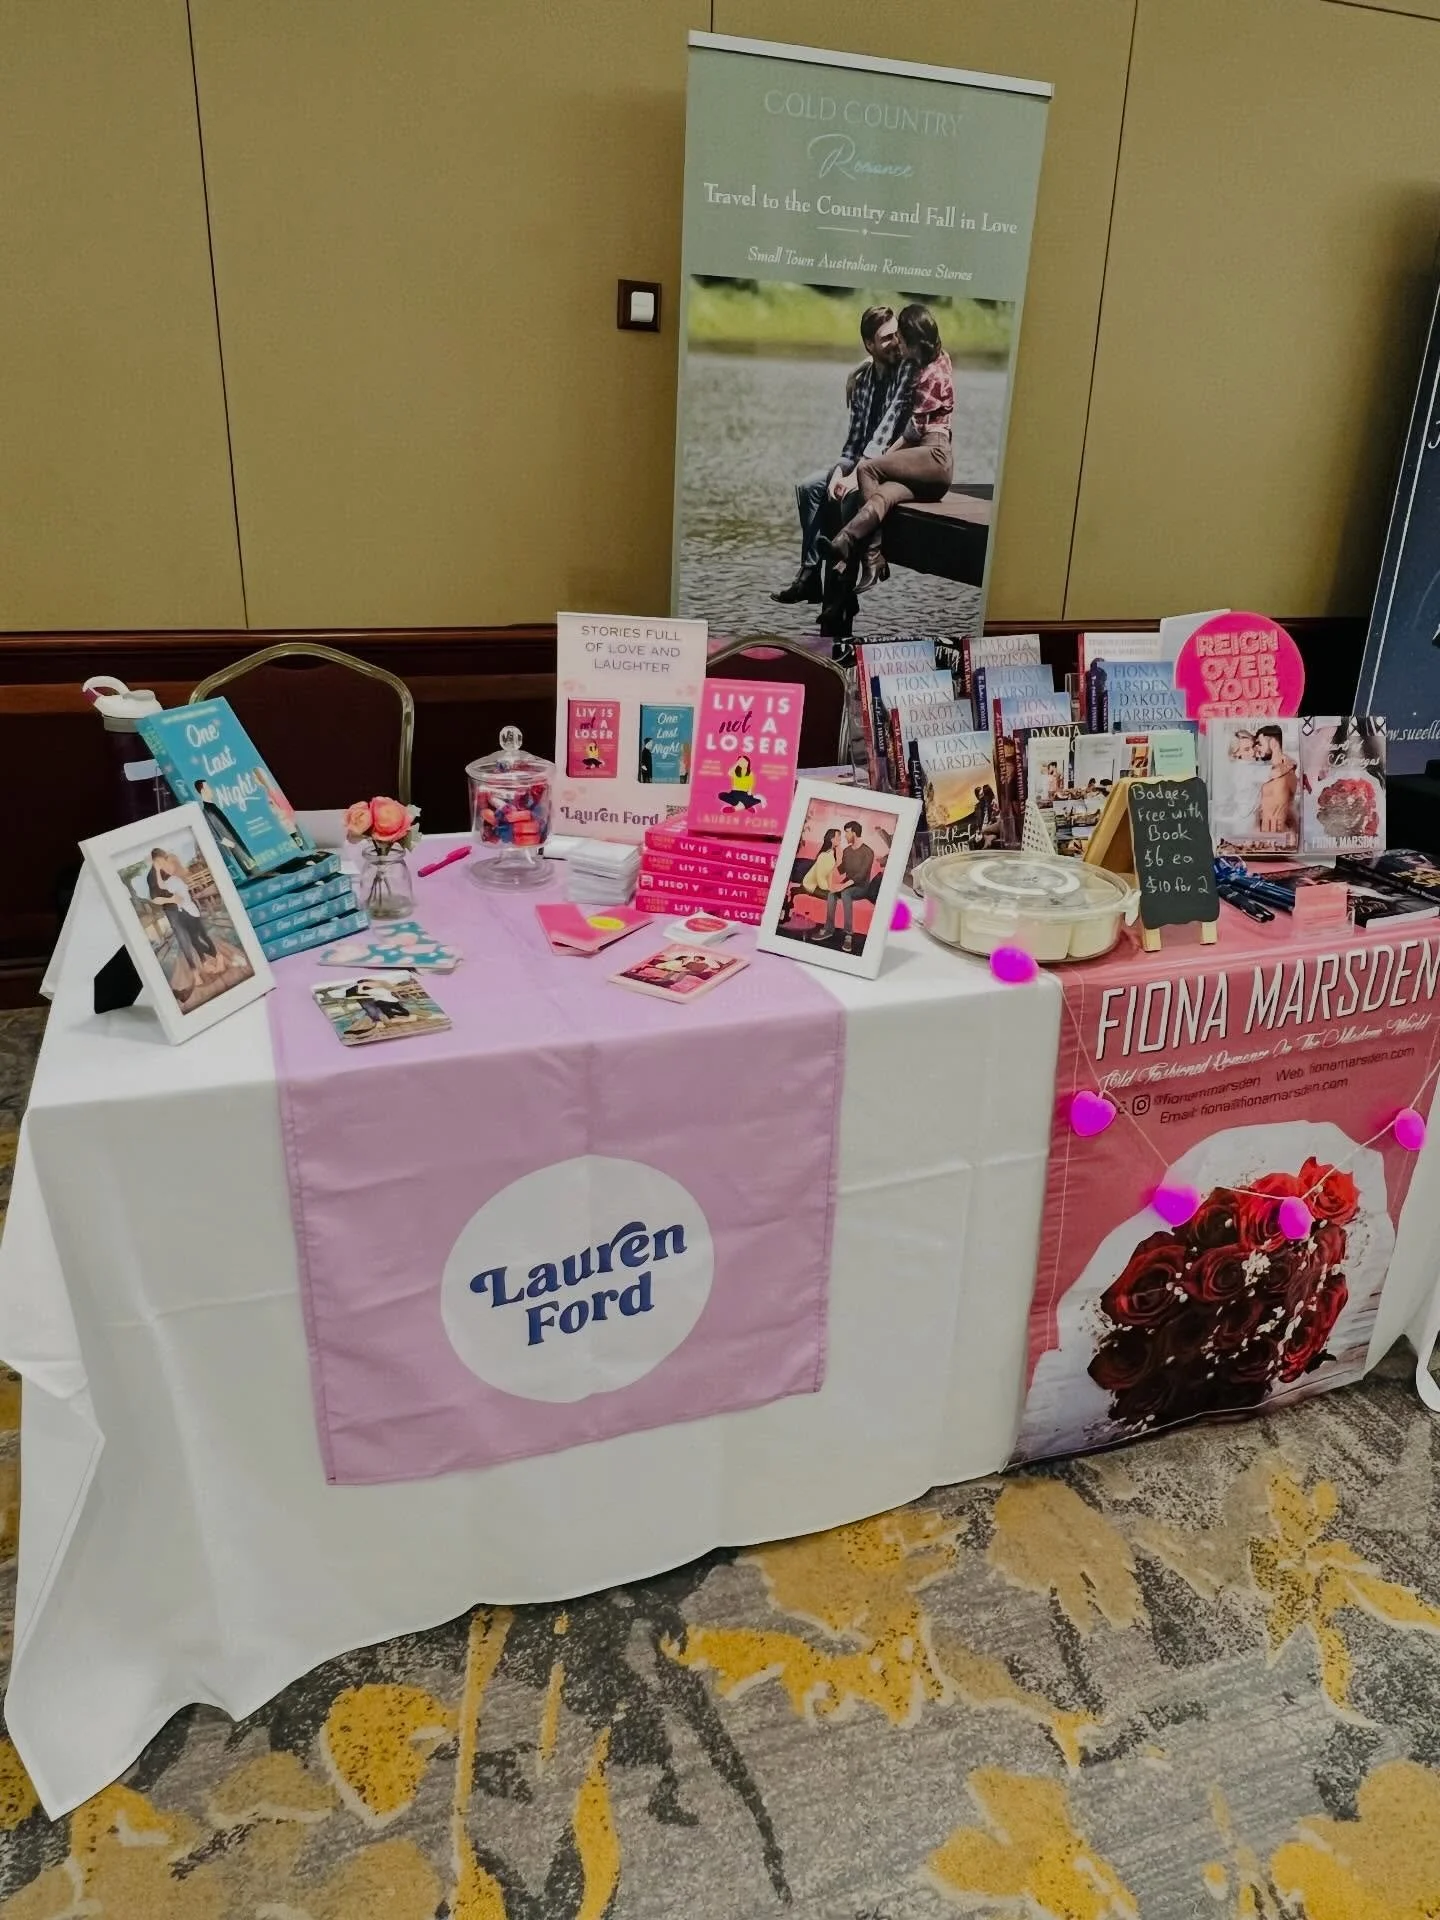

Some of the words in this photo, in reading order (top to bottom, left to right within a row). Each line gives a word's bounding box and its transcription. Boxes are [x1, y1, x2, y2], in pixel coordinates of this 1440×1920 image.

[844, 101, 963, 137] COUNTRY
[703, 183, 757, 207] Travel
[763, 192, 779, 209] to
[785, 189, 811, 213] the
[817, 196, 885, 223] Country
[890, 204, 920, 225] and
[927, 207, 955, 228] Fall
[961, 212, 976, 230] in
[982, 213, 1018, 234] Love
[747, 246, 782, 264] Small
[786, 249, 814, 267] Town
[819, 254, 877, 273] Australian
[883, 258, 932, 277] Romance
[936, 264, 973, 280] Stories
[581, 625, 640, 638] STORIES
[646, 629, 681, 641] FULL
[1197, 629, 1279, 657] REIGN
[585, 642, 603, 652] OF
[608, 644, 646, 656] LOVE
[651, 647, 681, 658] AND
[872, 646, 927, 661] DAKOTA
[594, 660, 670, 673] LAUGHTER
[867, 660, 936, 675] HARRISON
[1114, 664, 1158, 677] FIONA
[1200, 654, 1276, 680] OVER
[896, 674, 939, 691] FIONA
[1204, 675, 1280, 701] YOUR
[713, 693, 755, 711] LIV
[767, 696, 791, 714] IS
[887, 691, 954, 707] MARSDEN
[1016, 697, 1057, 712] FIONA
[1119, 690, 1176, 706] DAKOTA
[576, 707, 595, 718] LIV
[601, 708, 613, 718] IS
[657, 712, 679, 725] One
[718, 710, 752, 735] not
[761, 717, 777, 734] A
[909, 704, 963, 722] DAKOTA
[1113, 706, 1184, 721] HARRISON
[600, 719, 607, 728] A
[656, 727, 679, 738] Last
[904, 719, 973, 739] HARRISON
[1031, 725, 1081, 738] DAKOTA
[185, 723, 219, 748] One
[575, 729, 614, 739] LOSER
[651, 743, 681, 761] Night
[705, 734, 788, 755] LOSER
[935, 736, 980, 754] FIONA
[203, 745, 236, 776] Last
[924, 752, 992, 773] MARSDEN
[216, 771, 261, 812] Night
[1131, 784, 1190, 807] Badges
[560, 804, 619, 826] Lauren
[624, 810, 659, 826] Ford
[697, 812, 740, 828] LAUREN
[745, 814, 779, 830] FORD
[1137, 808, 1166, 822] Free
[1171, 802, 1203, 821] with
[1149, 823, 1192, 842] Book
[680, 842, 695, 851] LIV
[698, 845, 708, 854] IS
[735, 852, 767, 865] LOSER
[1144, 844, 1163, 866] $6
[1173, 853, 1193, 864] ea
[678, 863, 695, 873] LIV
[699, 866, 708, 874] IS
[737, 871, 769, 883] LOSER
[1145, 877, 1171, 894] $10
[1175, 877, 1192, 893] for
[1197, 876, 1209, 894] 2
[674, 904, 690, 913] LIV
[1095, 971, 1229, 1060] FIONA
[1244, 938, 1440, 1034] MARSDEN
[1138, 1055, 1212, 1085] Fashioned
[1213, 1049, 1269, 1072] Romance
[1296, 1030, 1325, 1052] The
[1322, 1025, 1383, 1049] Modern
[1387, 1015, 1433, 1035] World
[1309, 1046, 1415, 1075] fionamarsden.com
[1200, 1078, 1349, 1115] fiona@fionamarsden.com
[469, 1221, 687, 1308] Lauren
[525, 1271, 655, 1346] Ford
